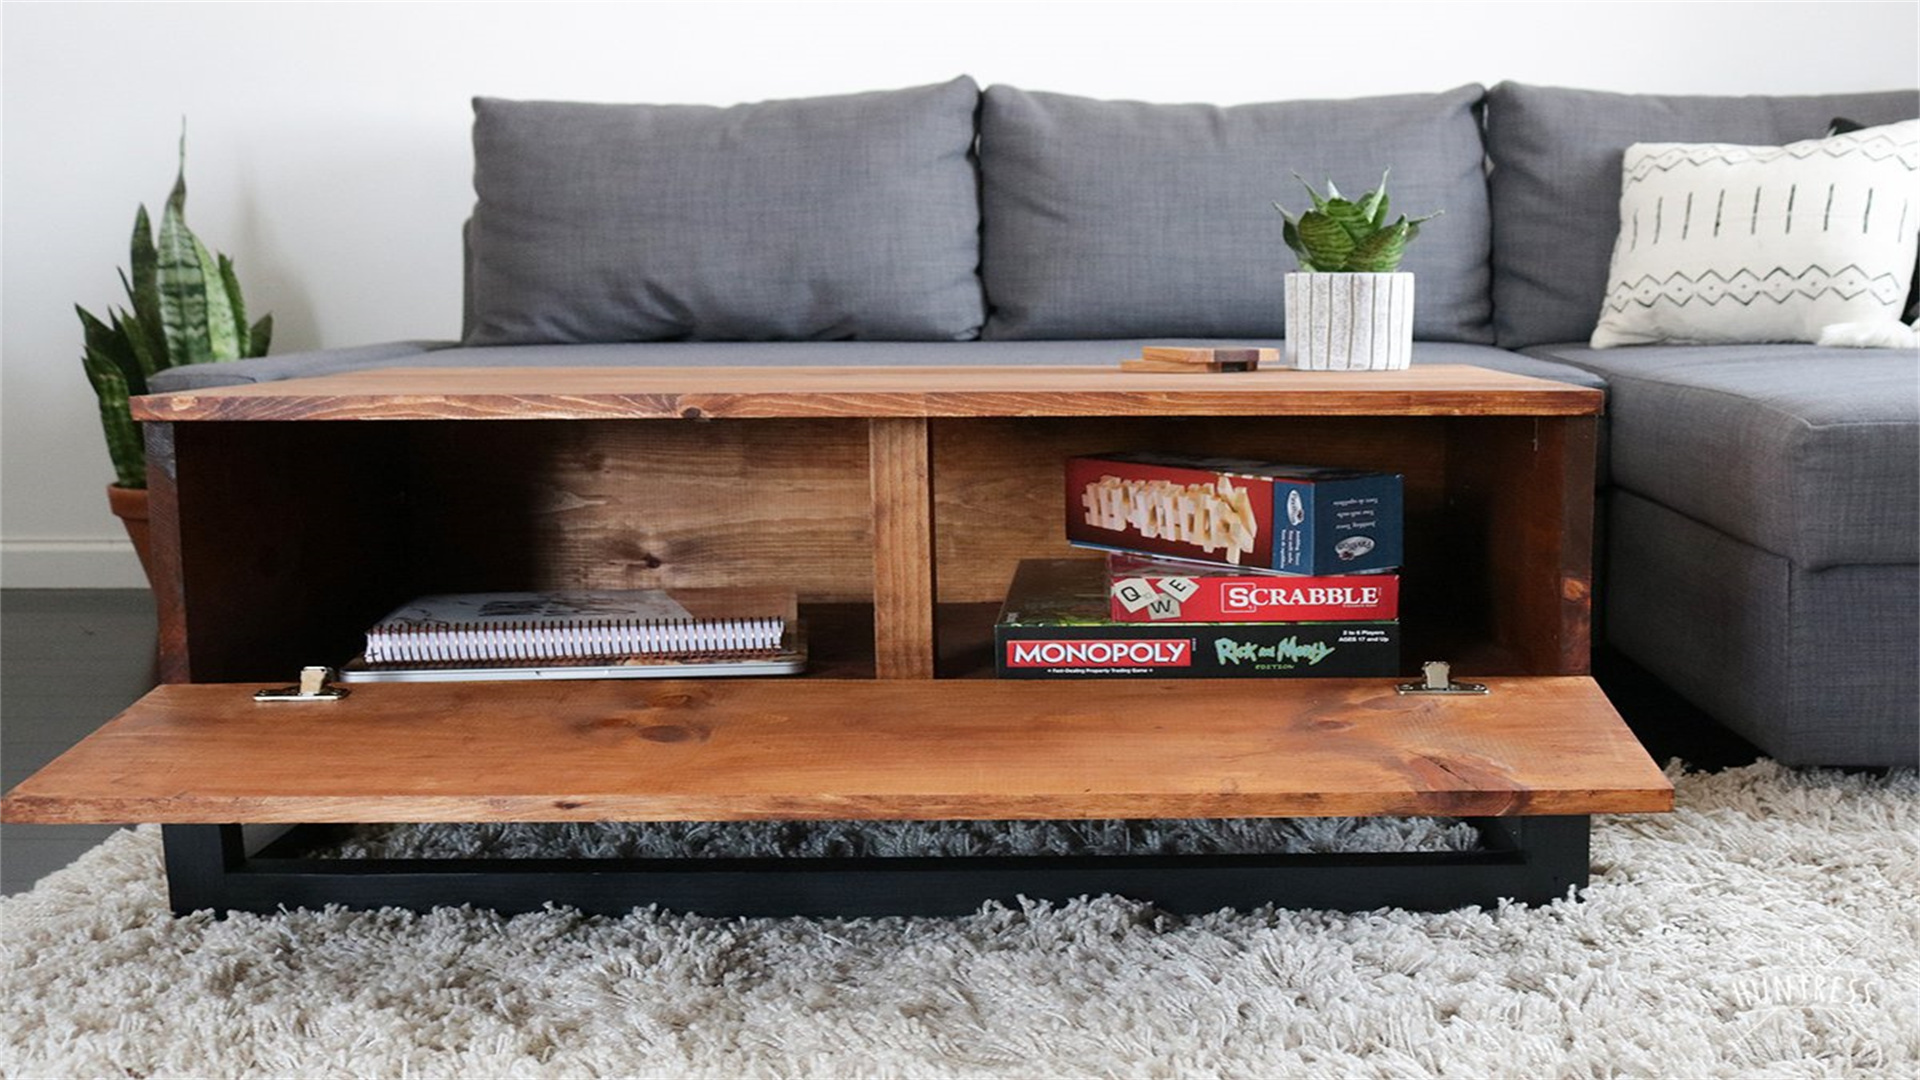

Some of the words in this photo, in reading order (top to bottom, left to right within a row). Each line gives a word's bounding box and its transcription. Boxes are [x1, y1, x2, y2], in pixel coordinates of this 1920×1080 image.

[1169, 579, 1187, 592] E
[1120, 586, 1141, 602] Q
[1228, 586, 1379, 608] SCRABBLE
[1150, 600, 1171, 614] W
[1013, 642, 1186, 664] MONOPOLY
